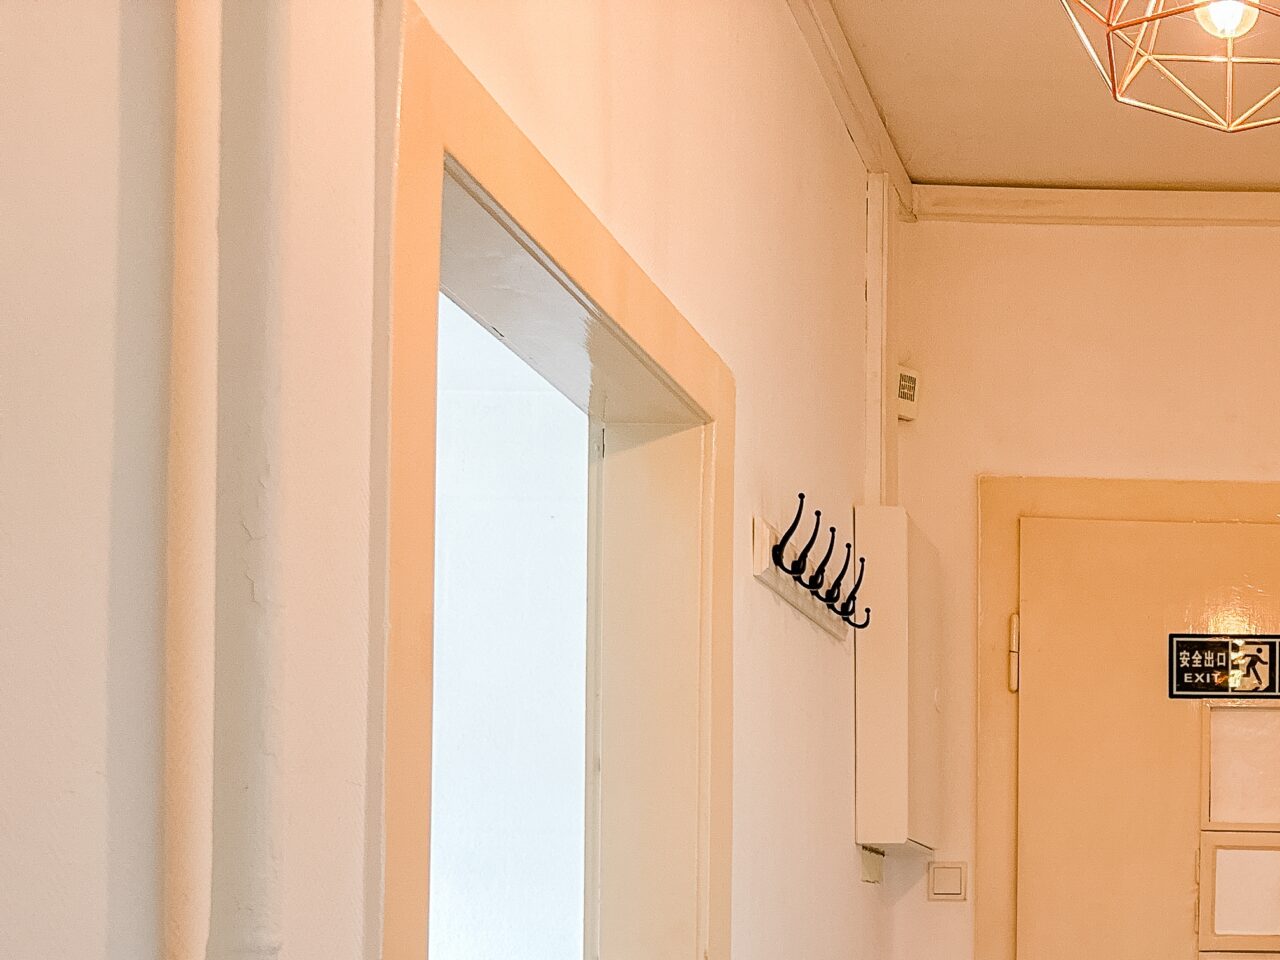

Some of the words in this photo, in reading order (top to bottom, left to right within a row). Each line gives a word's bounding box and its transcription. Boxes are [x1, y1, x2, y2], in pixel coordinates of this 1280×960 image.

[1179, 650, 1226, 668] 安全出口
[1184, 673, 1220, 683] EXIT
